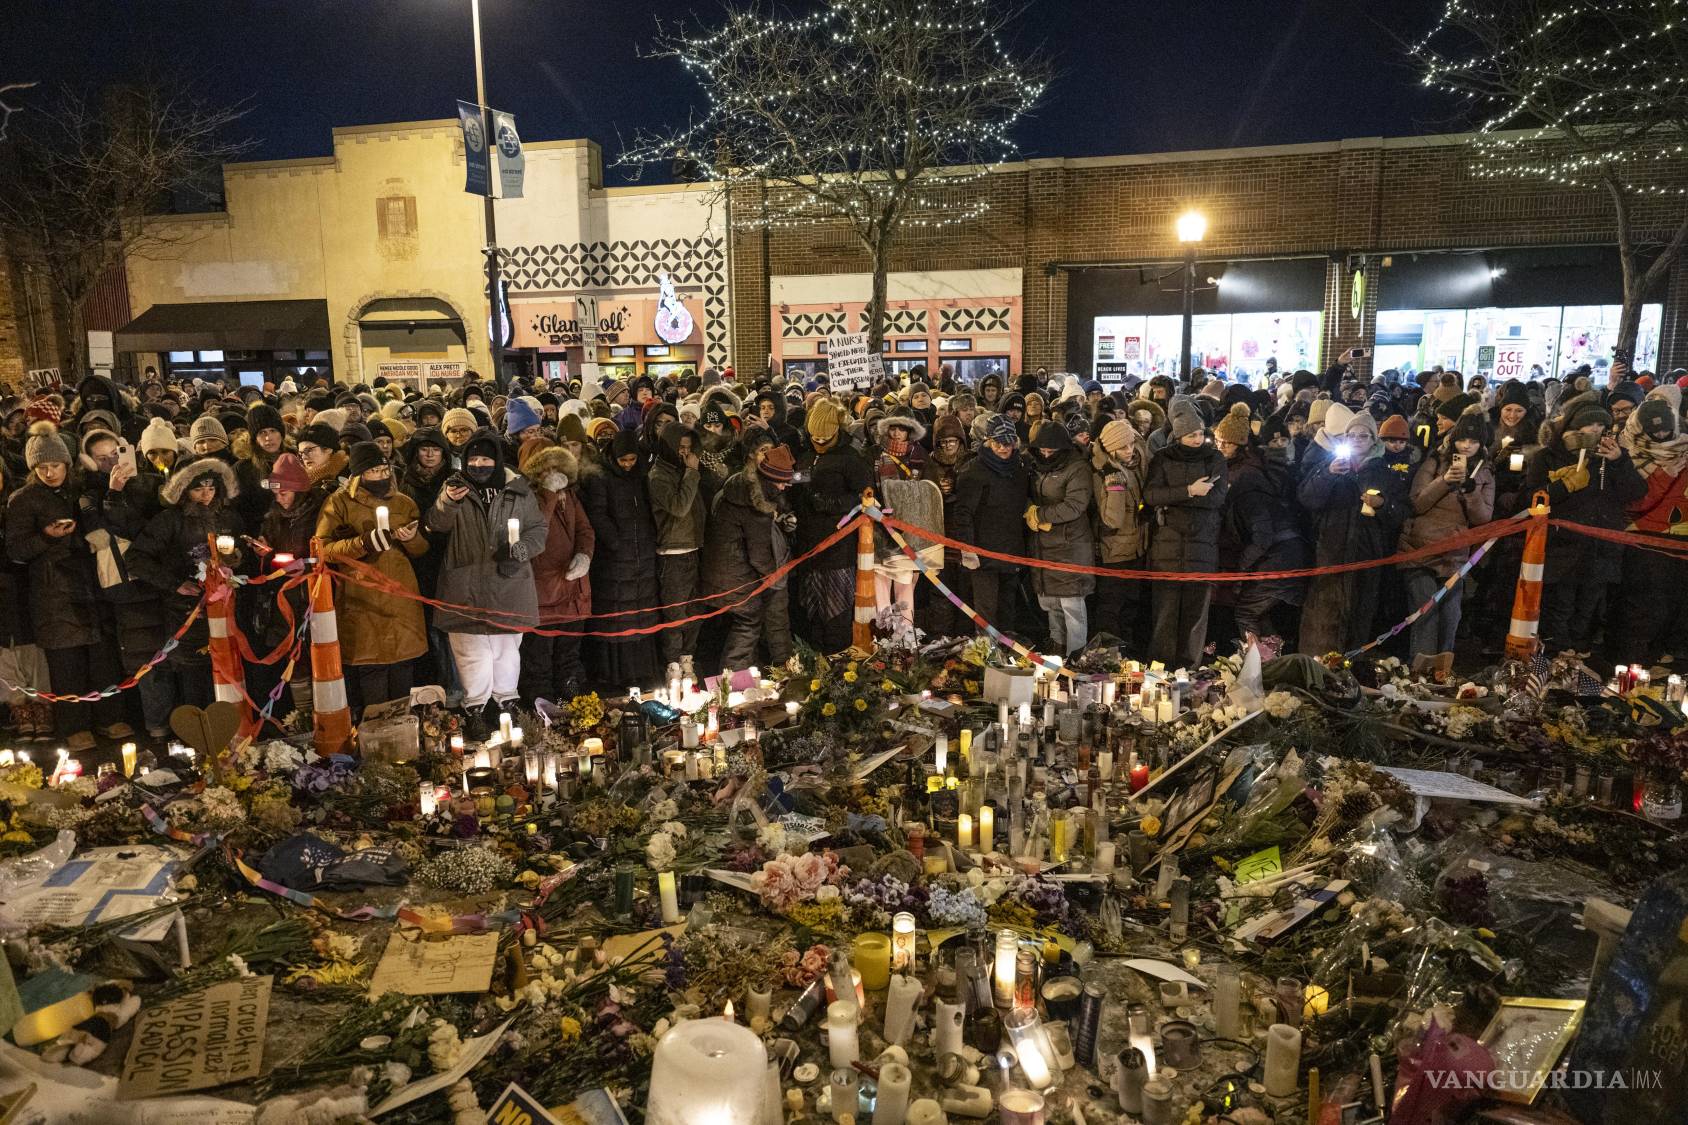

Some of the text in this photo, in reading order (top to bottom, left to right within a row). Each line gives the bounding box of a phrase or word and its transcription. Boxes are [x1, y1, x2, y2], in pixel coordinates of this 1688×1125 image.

[600, 312, 625, 332] oll
[549, 333, 620, 346] DONTS
[829, 335, 863, 348] A NURSE
[838, 357, 867, 368] EXECUTED
[1498, 351, 1523, 363] ICE
[831, 370, 844, 379] FOR
[203, 1000, 230, 1074] normalized
[227, 1004, 257, 1057] cruelty
[156, 991, 207, 1090] OMPASSION
[128, 1020, 167, 1082] RADICAL
[231, 1059, 251, 1074] is
